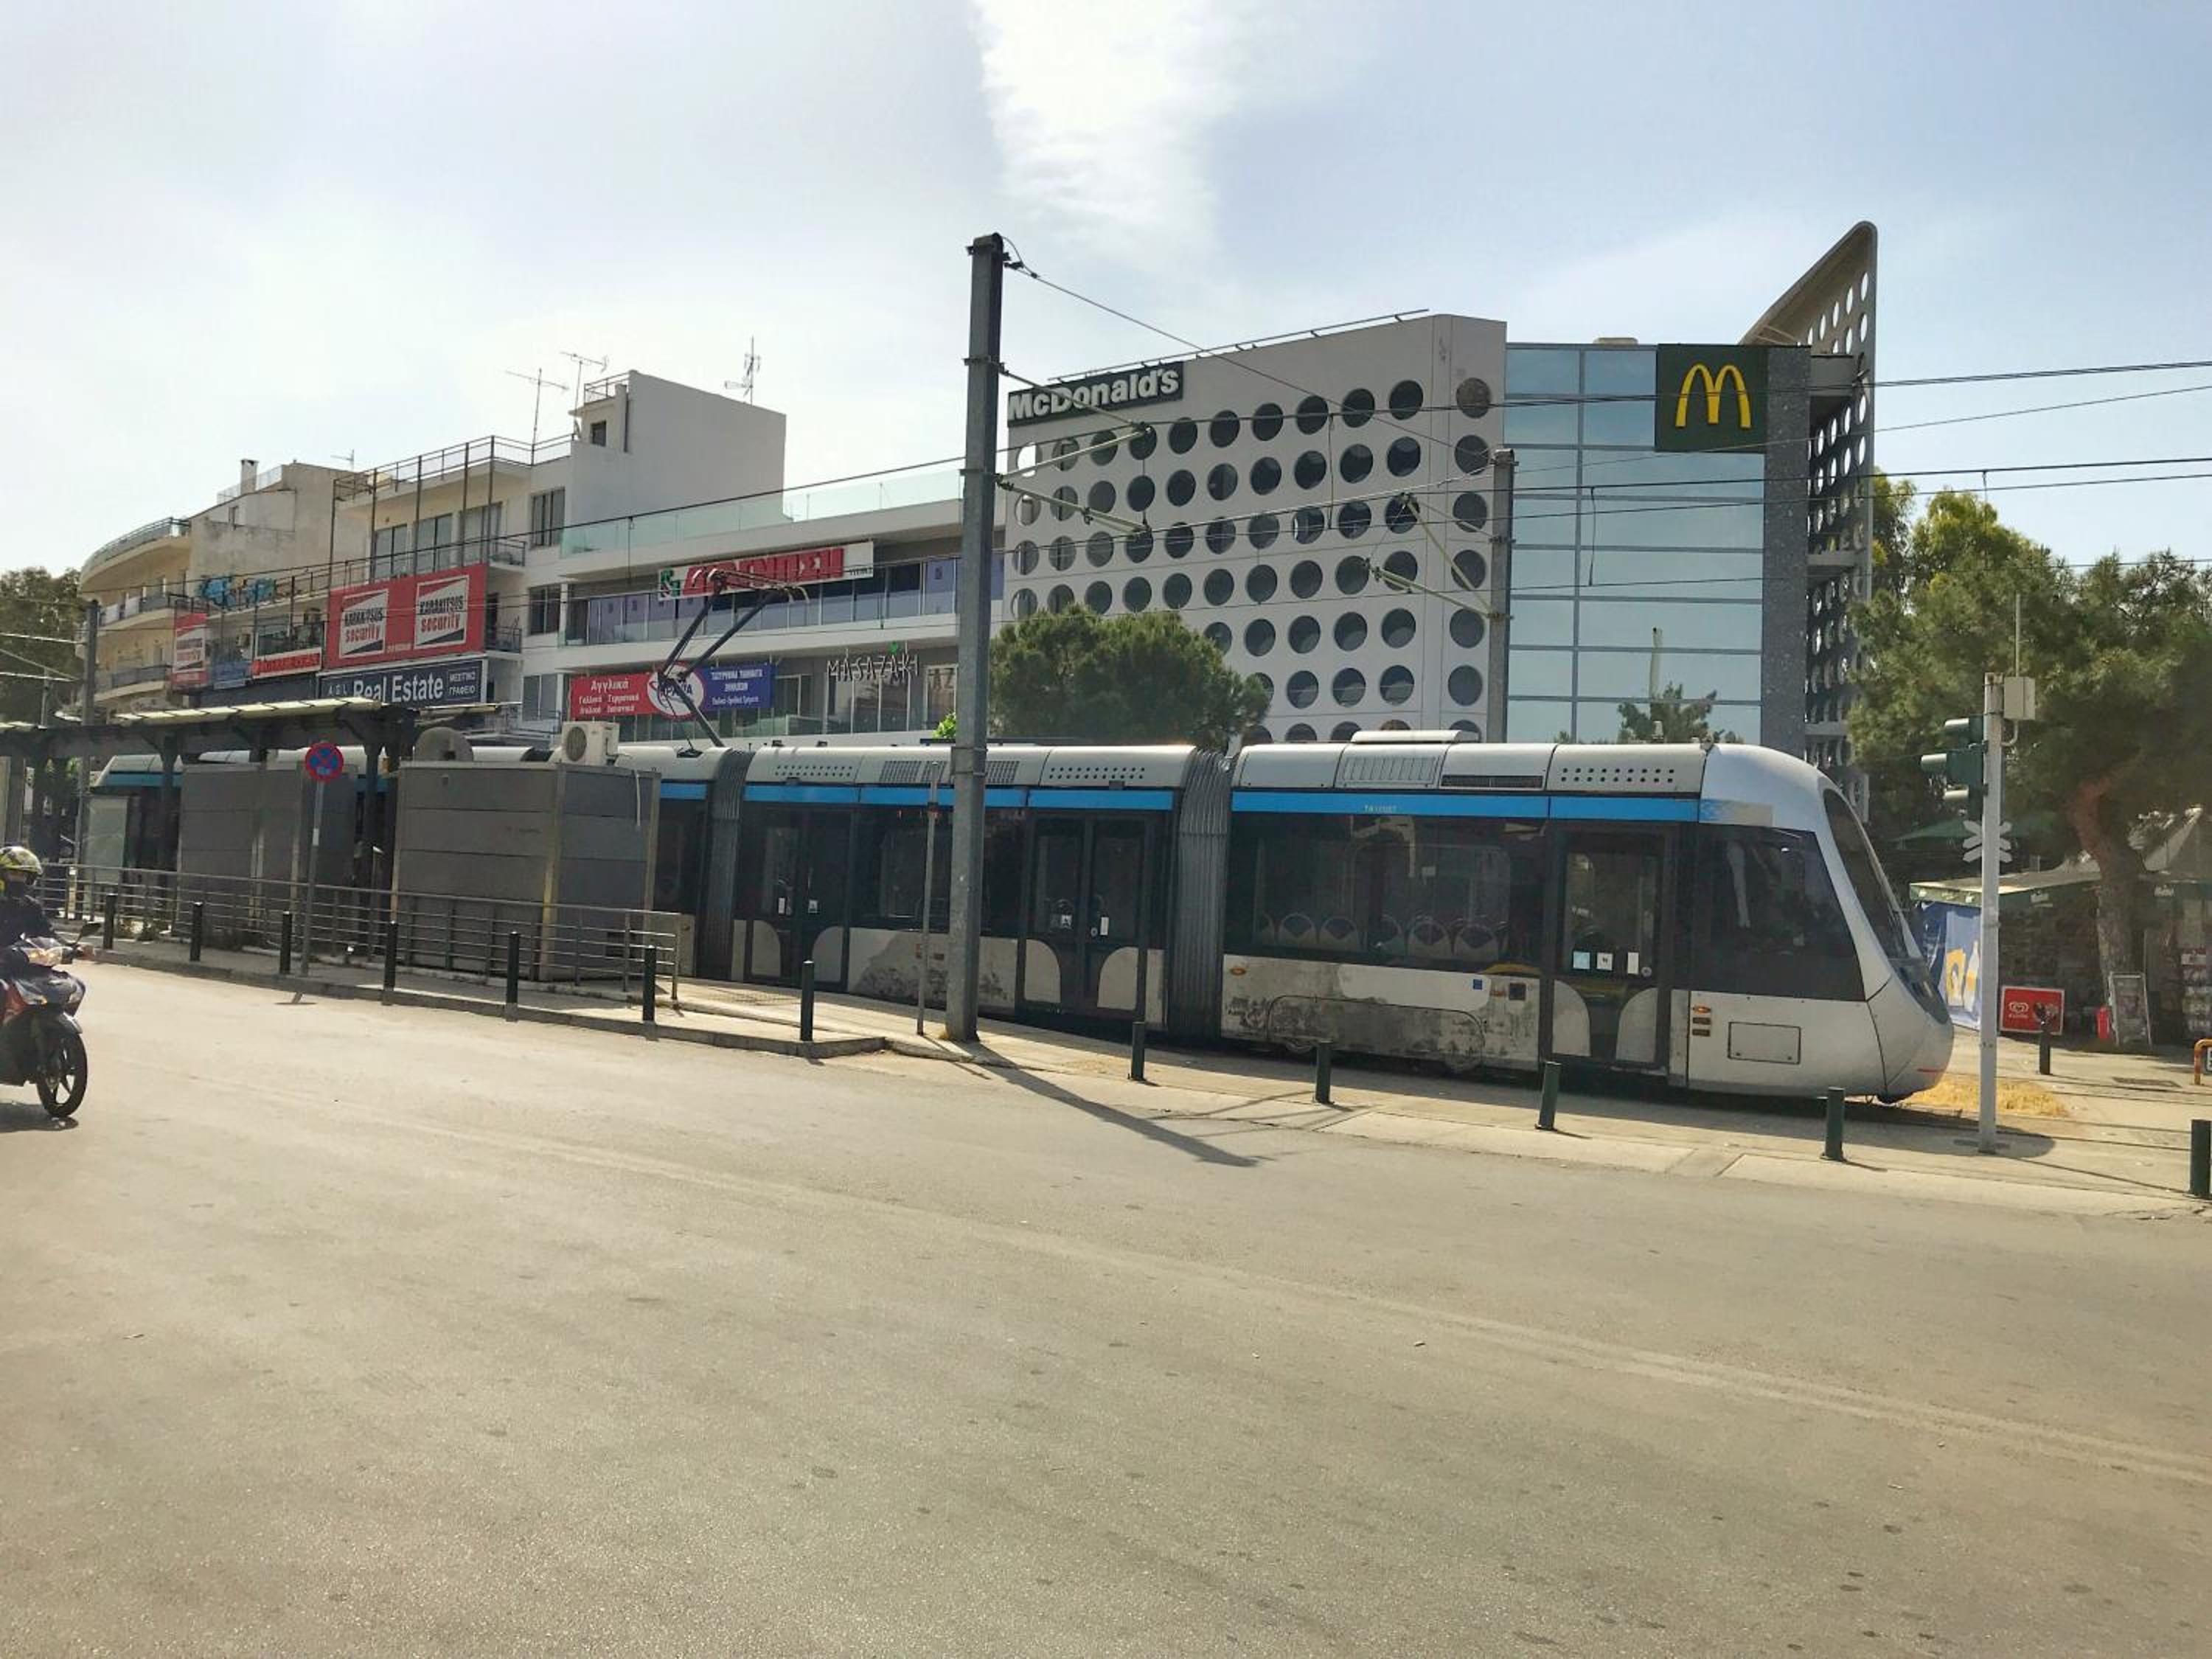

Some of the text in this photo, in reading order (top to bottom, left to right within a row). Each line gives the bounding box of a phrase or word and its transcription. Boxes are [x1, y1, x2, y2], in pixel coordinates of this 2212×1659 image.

[1008, 369, 1179, 420] McDonald's
[421, 613, 461, 633] security
[827, 653, 919, 682] MASAZAKI
[353, 675, 387, 702] Real
[392, 672, 443, 703] Estate
[591, 678, 629, 694] Αγγλικά
